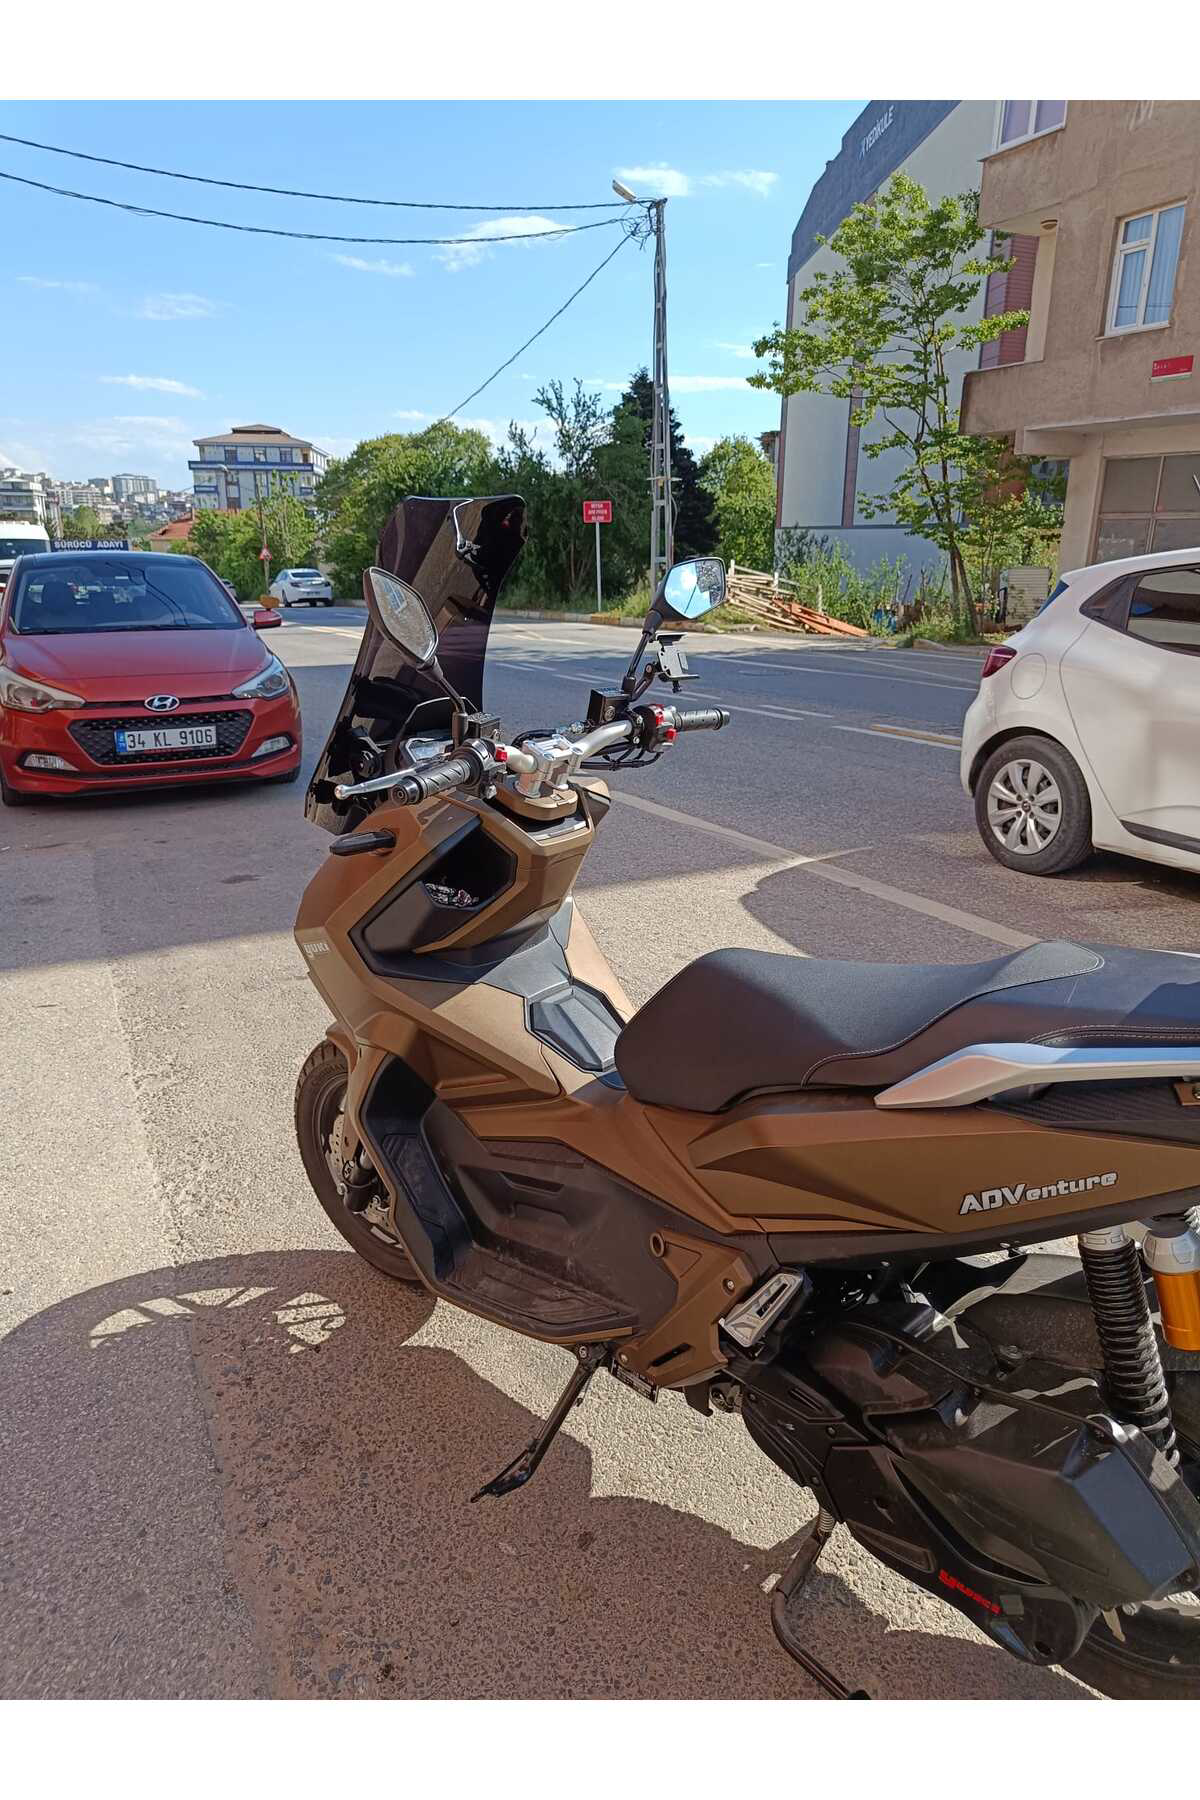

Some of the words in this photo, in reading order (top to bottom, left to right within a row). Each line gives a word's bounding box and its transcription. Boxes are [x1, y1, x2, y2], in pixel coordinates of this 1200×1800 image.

[54, 539, 92, 549] SÜRÜCÜ
[96, 540, 124, 549] ADAYI
[127, 733, 146, 749] 34
[153, 731, 172, 747] KL
[179, 728, 213, 745] 9106
[959, 1172, 1118, 1215] ADVenture
